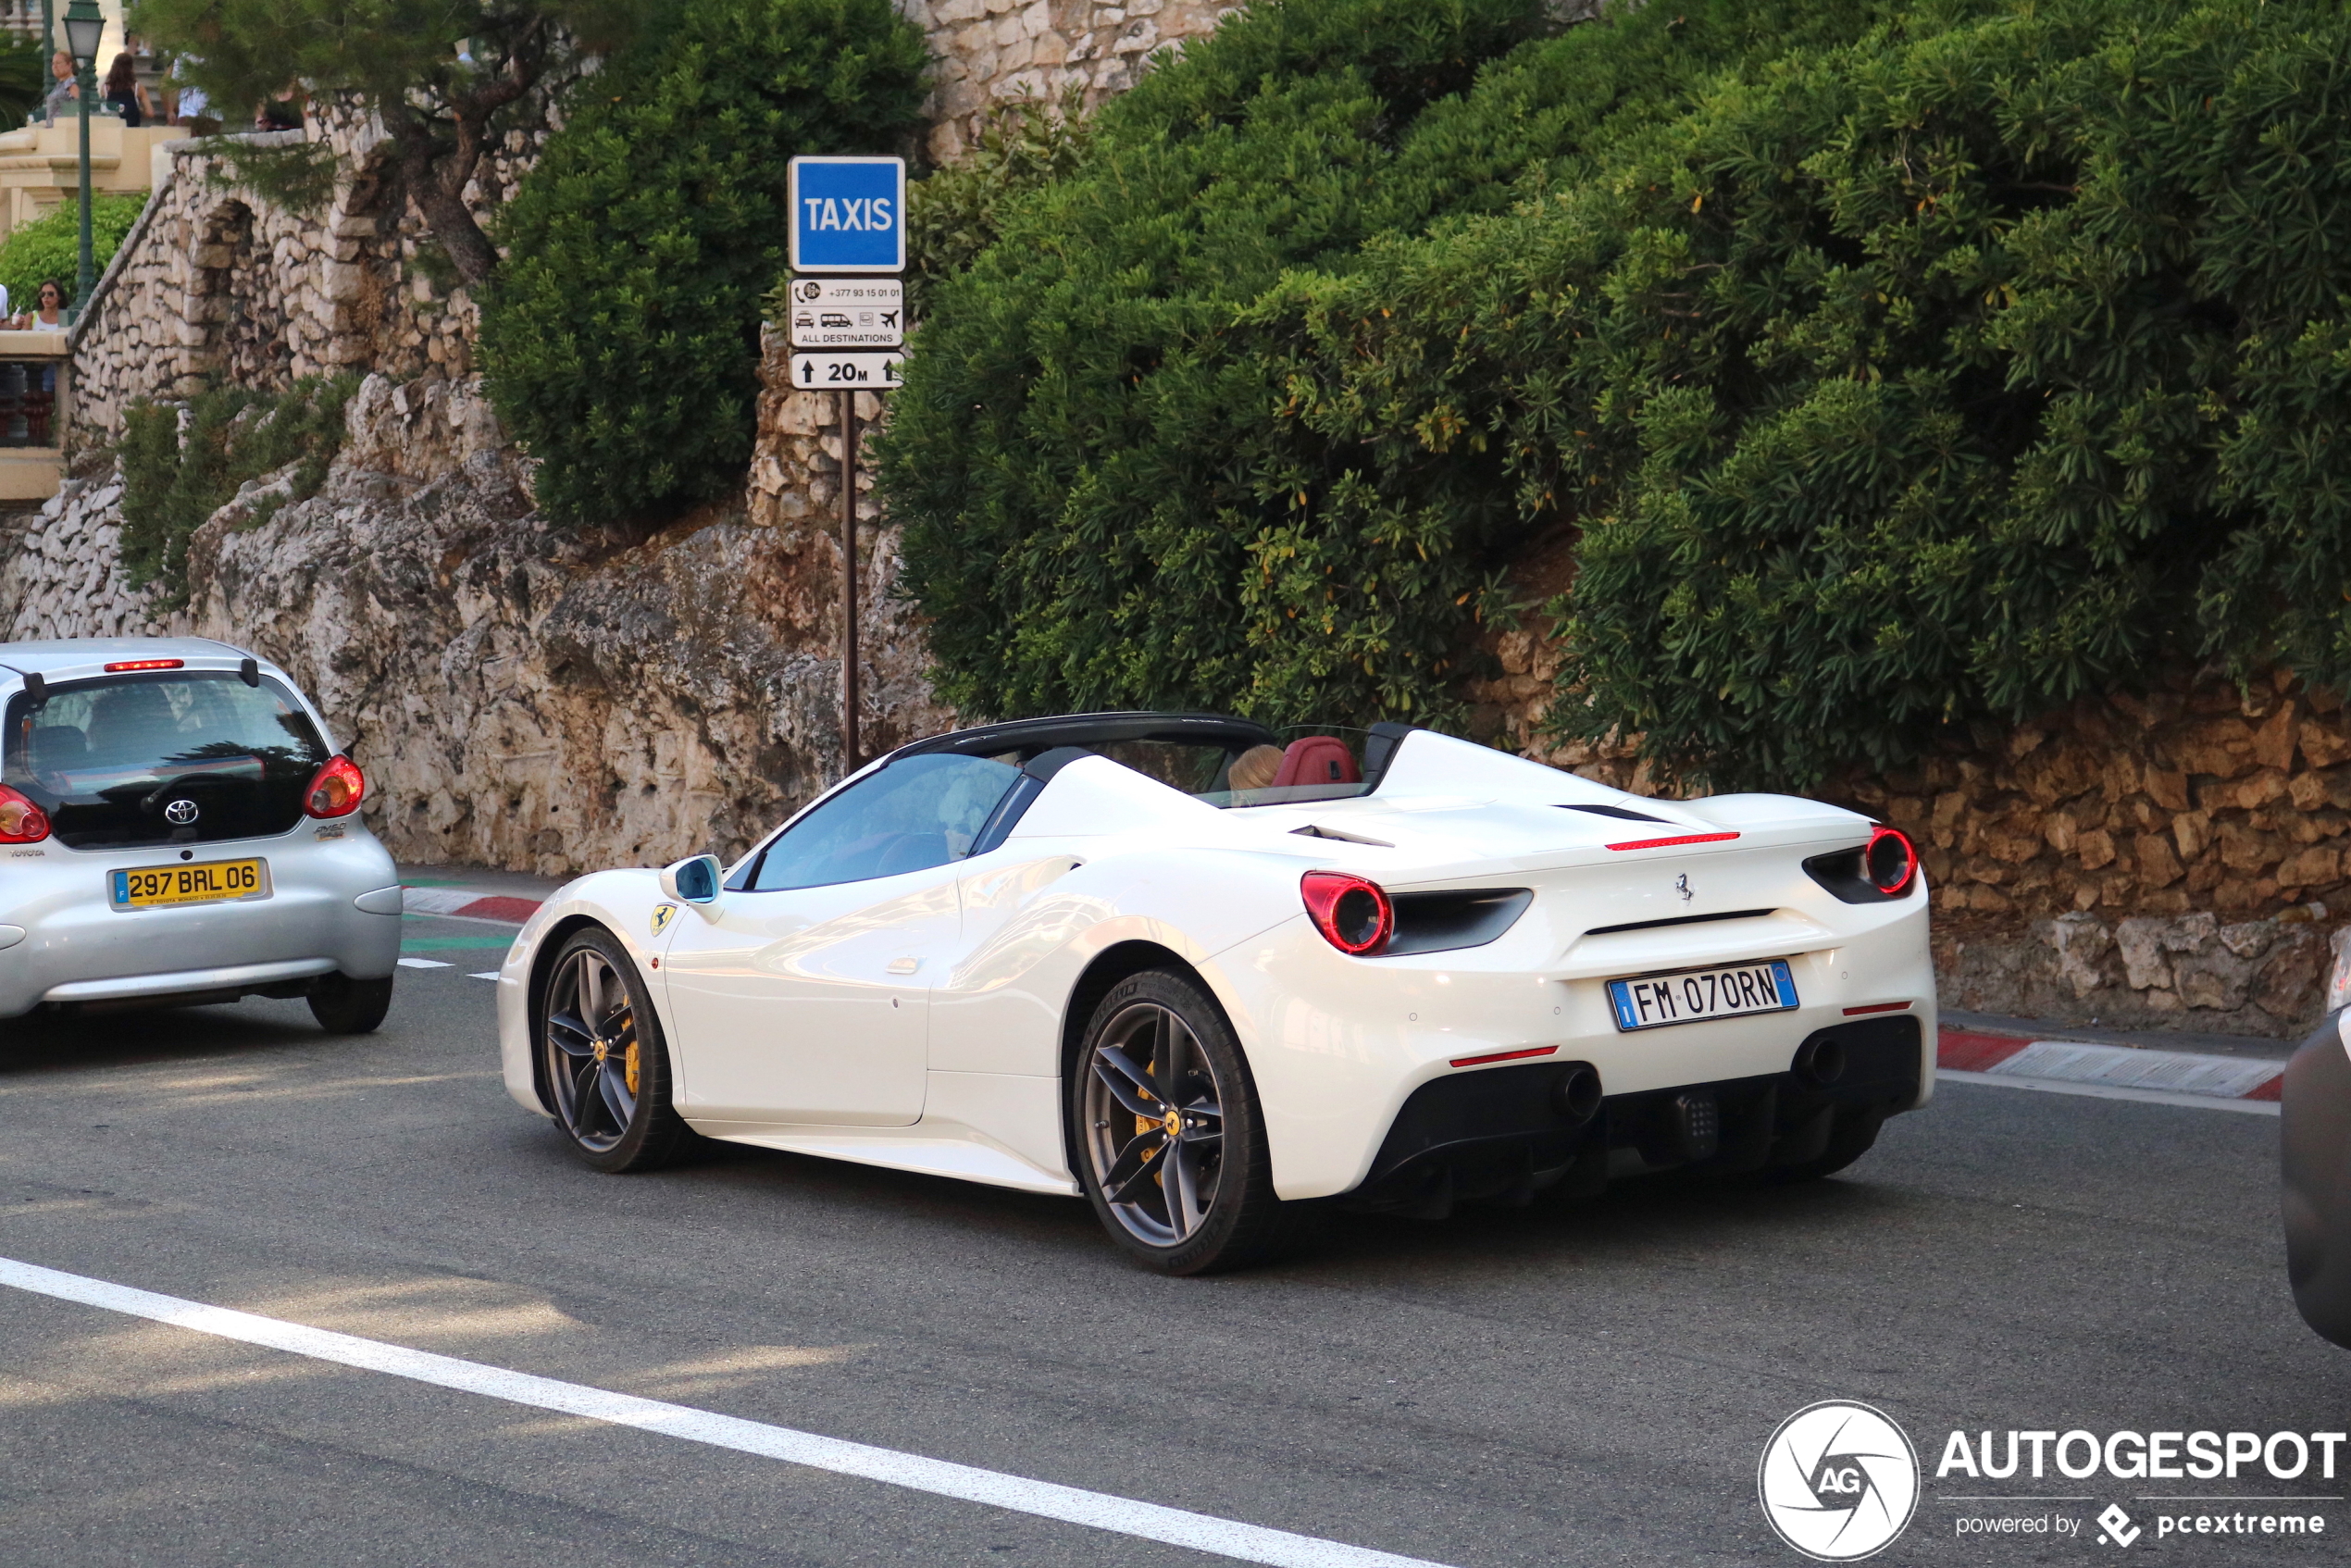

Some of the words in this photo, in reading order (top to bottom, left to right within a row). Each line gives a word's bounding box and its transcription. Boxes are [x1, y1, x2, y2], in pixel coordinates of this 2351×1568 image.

[804, 197, 893, 231] TAXIS
[829, 289, 851, 297] +377
[853, 289, 864, 297] 93
[866, 289, 877, 297] 15
[878, 289, 887, 297] 01
[890, 289, 900, 297] 01
[802, 334, 820, 342] ALL
[823, 334, 893, 342] DESTINATIONS
[129, 873, 173, 898] 297
[178, 869, 223, 894] BRL
[227, 865, 255, 890] 06
[1633, 981, 1677, 1022] FM
